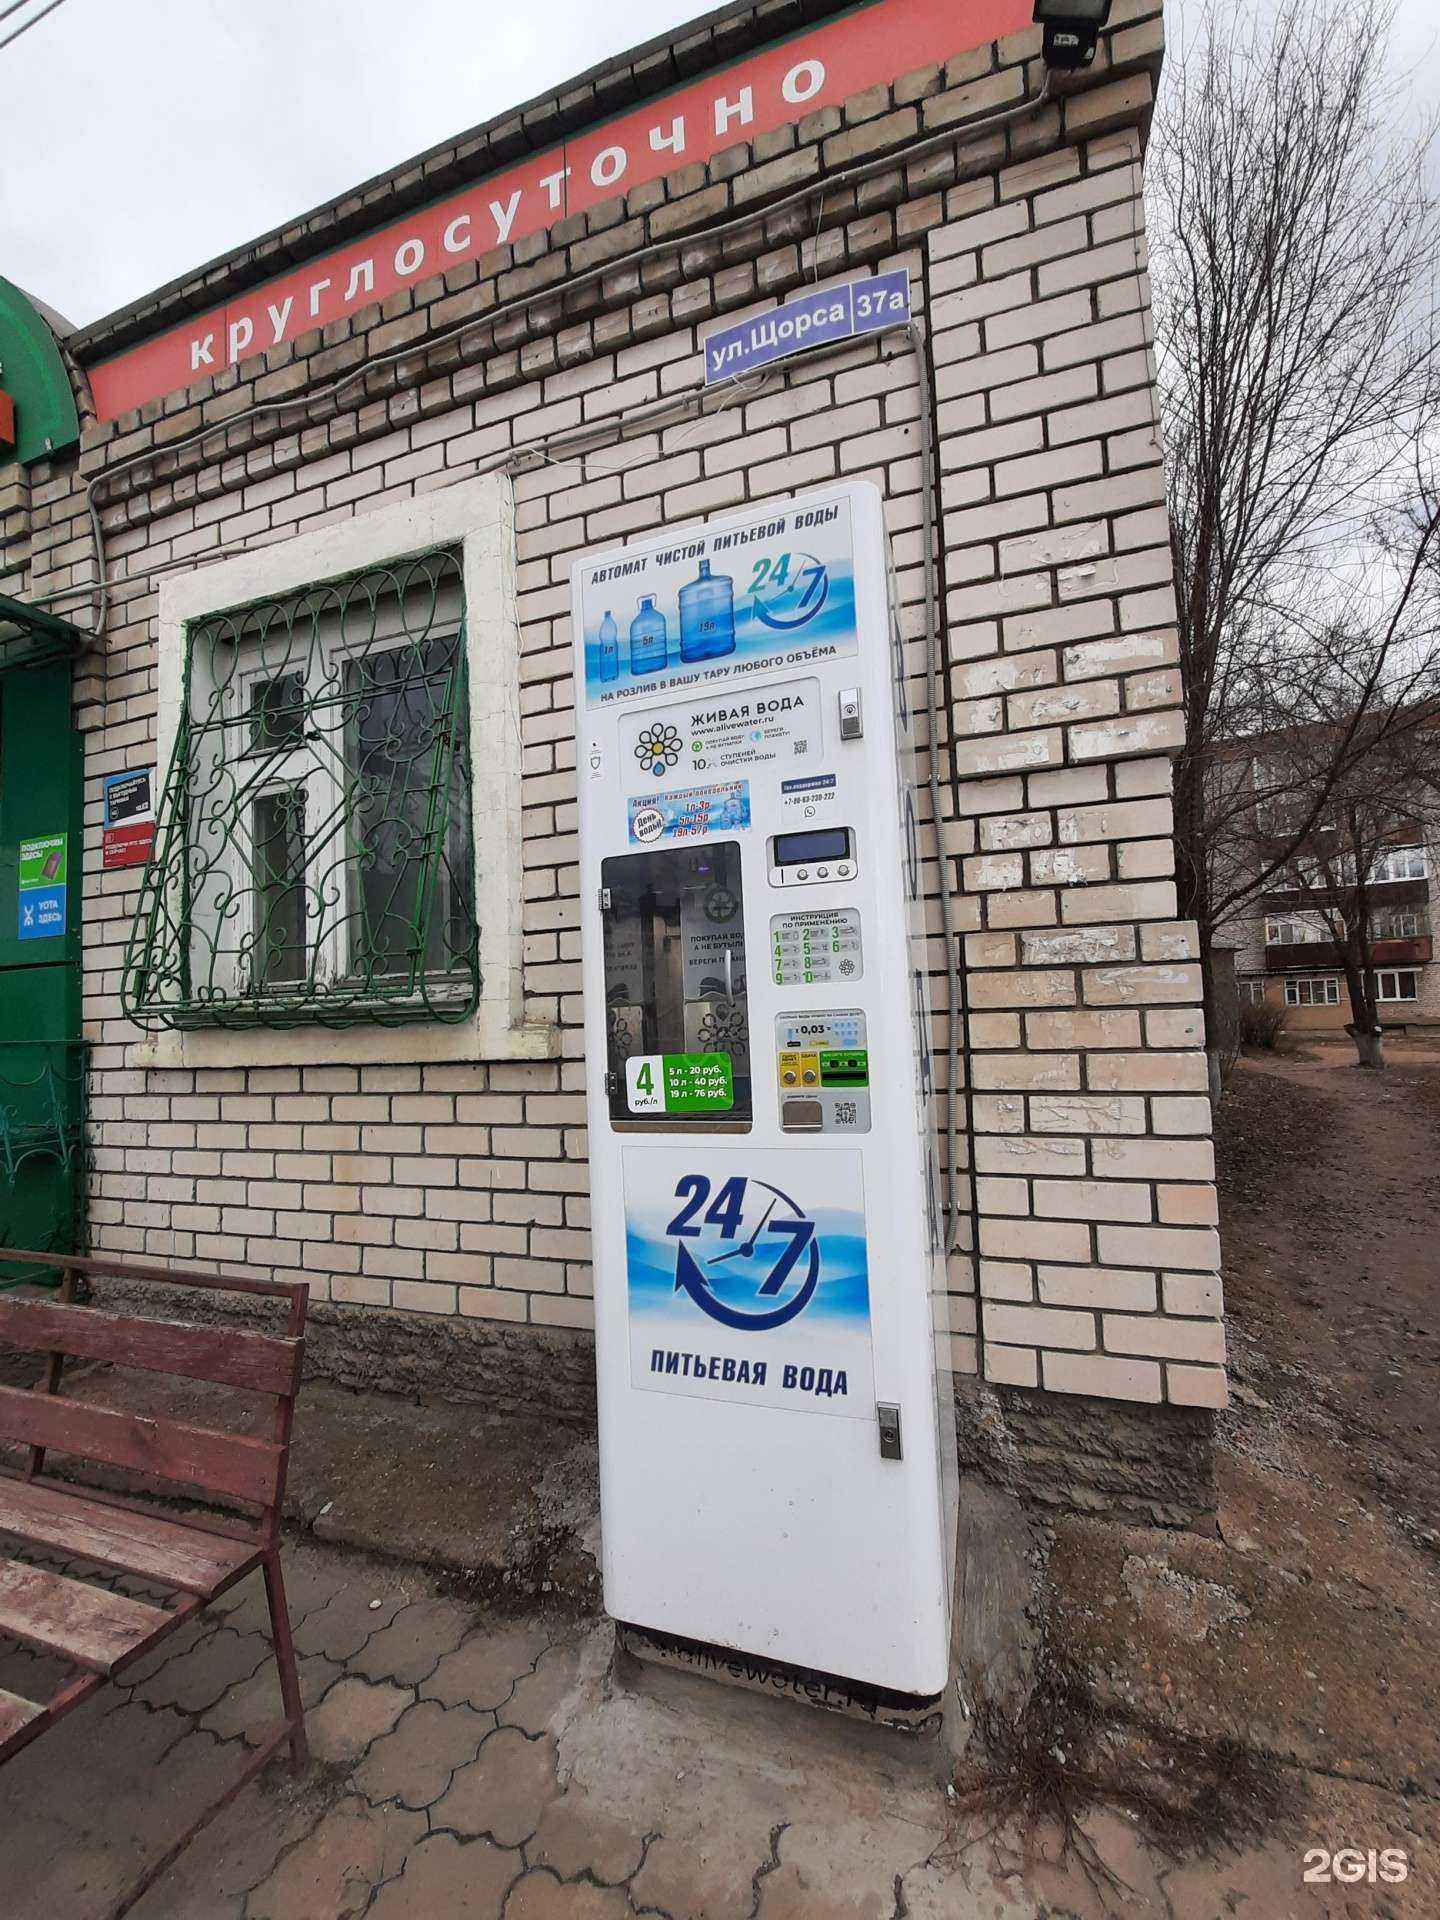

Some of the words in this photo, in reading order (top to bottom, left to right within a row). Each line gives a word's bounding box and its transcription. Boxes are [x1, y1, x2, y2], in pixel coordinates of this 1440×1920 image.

[712, 303, 845, 371] ул.Щорса
[857, 289, 905, 318] 37а
[591, 558, 648, 585] АВТОМАТ
[656, 539, 706, 566] ЧИСТОЙ
[713, 517, 786, 552] ПИТЬЕВОЙ
[794, 504, 839, 531] ВОДЫ
[747, 552, 792, 594] 24
[601, 692, 614, 702] НА
[617, 682, 657, 699] РОЗЛИВ
[660, 681, 667, 690] В
[669, 673, 700, 688] ВАШУ
[703, 666, 731, 680] ТАРУ
[733, 656, 783, 674] ЛЮБОГО
[787, 646, 837, 663] ОБЪЁМА
[691, 705, 750, 727] ЖИВАЯ
[756, 695, 805, 715] ВОДА
[691, 716, 774, 737] www.alivewater.ru
[720, 749, 756, 760] СТУПЕНЕЙ
[720, 756, 753, 767] ОЧИСТКИ
[754, 753, 776, 762] ВОДЫ
[773, 931, 780, 943] 1
[802, 928, 810, 941] 2
[832, 926, 839, 939] 3
[774, 945, 783, 957] 4
[803, 942, 811, 955] 5
[832, 940, 840, 953] 6
[774, 959, 782, 971] 7
[804, 957, 811, 969] 8
[775, 973, 783, 985] 9
[636, 1062, 655, 1096] 4
[669, 1067, 675, 1076] 5
[689, 1066, 701, 1075] 20
[702, 1065, 722, 1076] руб.
[669, 1078, 678, 1087] 10
[694, 1077, 706, 1086] 40
[708, 1076, 728, 1088] руб.
[670, 1089, 679, 1098] 19
[694, 1089, 705, 1097] 76
[707, 1088, 727, 1099] руб.
[665, 1174, 748, 1239] 24
[758, 1220, 815, 1295] 7
[651, 1349, 768, 1386] ПИТЬЕВАЯ
[782, 1364, 848, 1397] ВОДА
